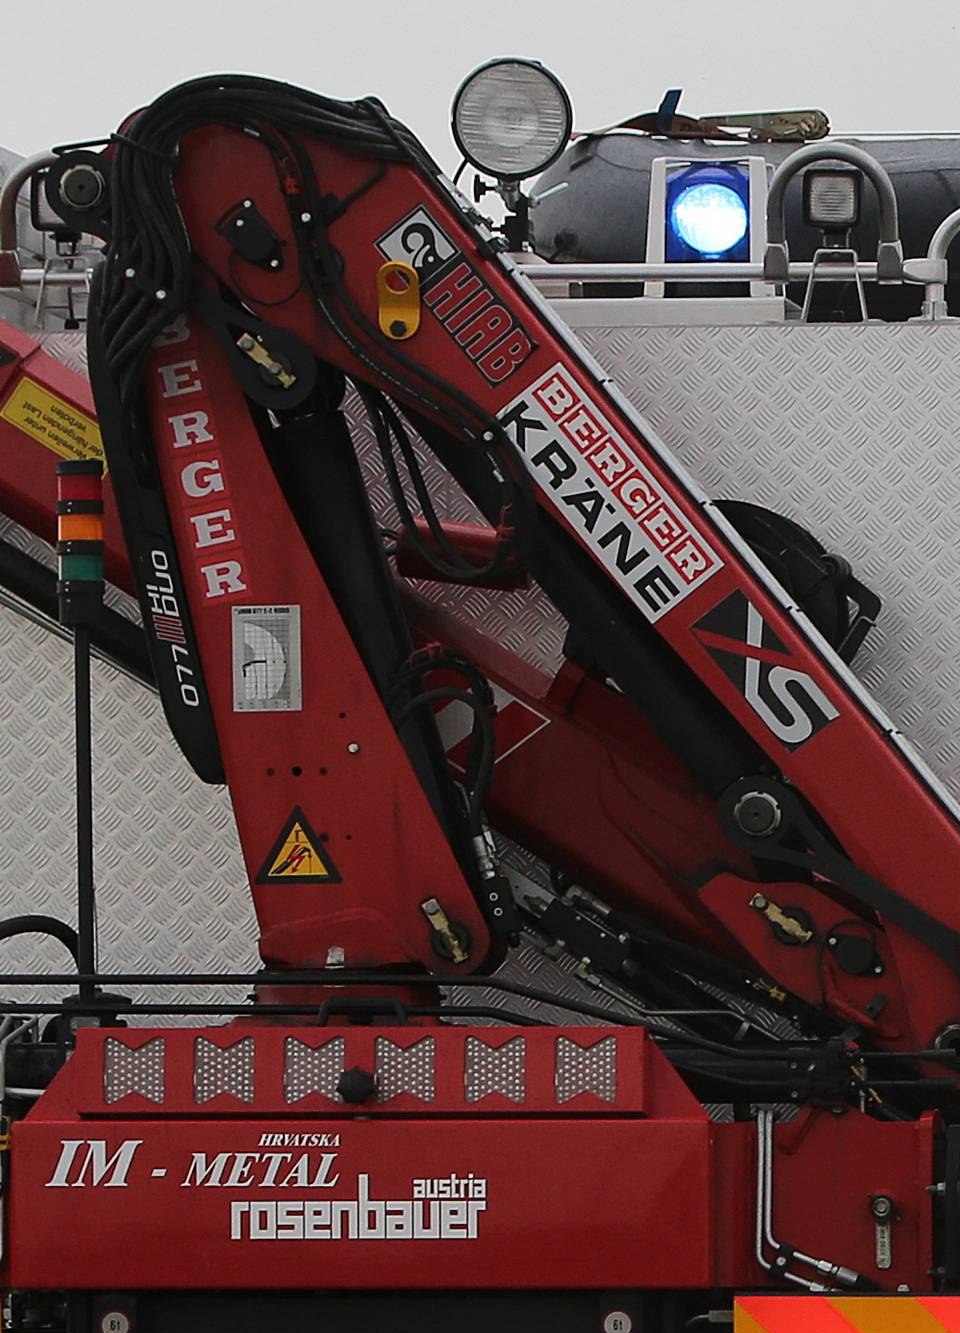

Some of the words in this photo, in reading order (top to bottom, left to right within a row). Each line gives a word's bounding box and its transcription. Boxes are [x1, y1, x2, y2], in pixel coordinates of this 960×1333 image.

[422, 262, 532, 382] HIAB
[500, 400, 681, 613] KRÄNE
[533, 373, 714, 585] BERGER
[171, 644, 200, 707] 077
[45, 1139, 143, 1188] IM
[181, 1152, 340, 1188] METAL
[258, 1133, 342, 1147] HRVATSKA
[230, 1174, 487, 1240] rosenbauer
[413, 1174, 487, 1199] austria
